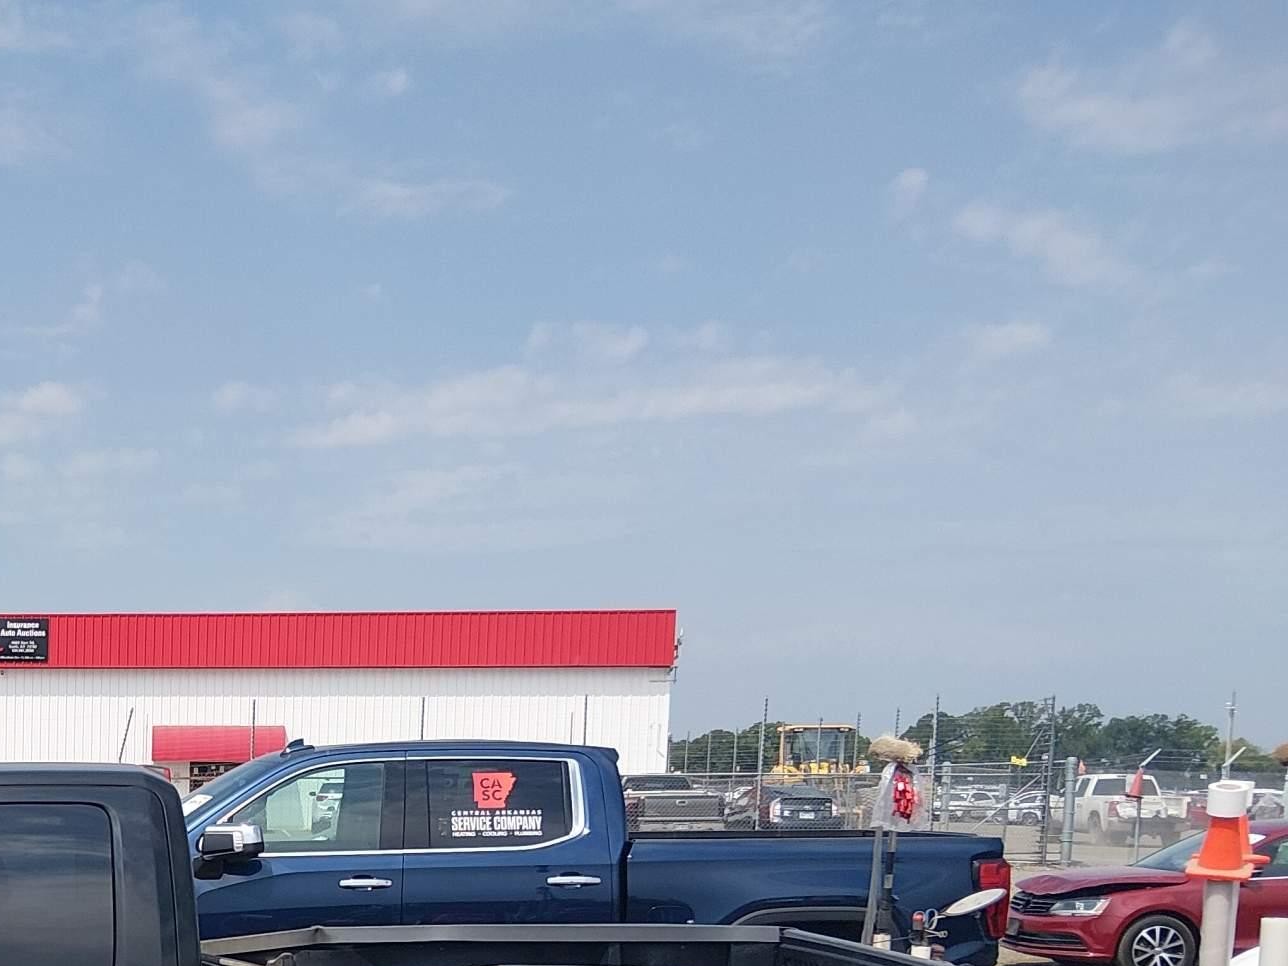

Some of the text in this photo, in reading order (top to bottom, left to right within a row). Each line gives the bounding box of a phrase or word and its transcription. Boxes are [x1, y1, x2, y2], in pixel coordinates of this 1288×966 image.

[7, 621, 39, 629] Insurance
[0, 629, 46, 637] Auto Auctions
[480, 778, 502, 789] CA
[482, 789, 503, 801] SC
[451, 816, 492, 831] SERVICE
[493, 816, 542, 830] COMPANY
